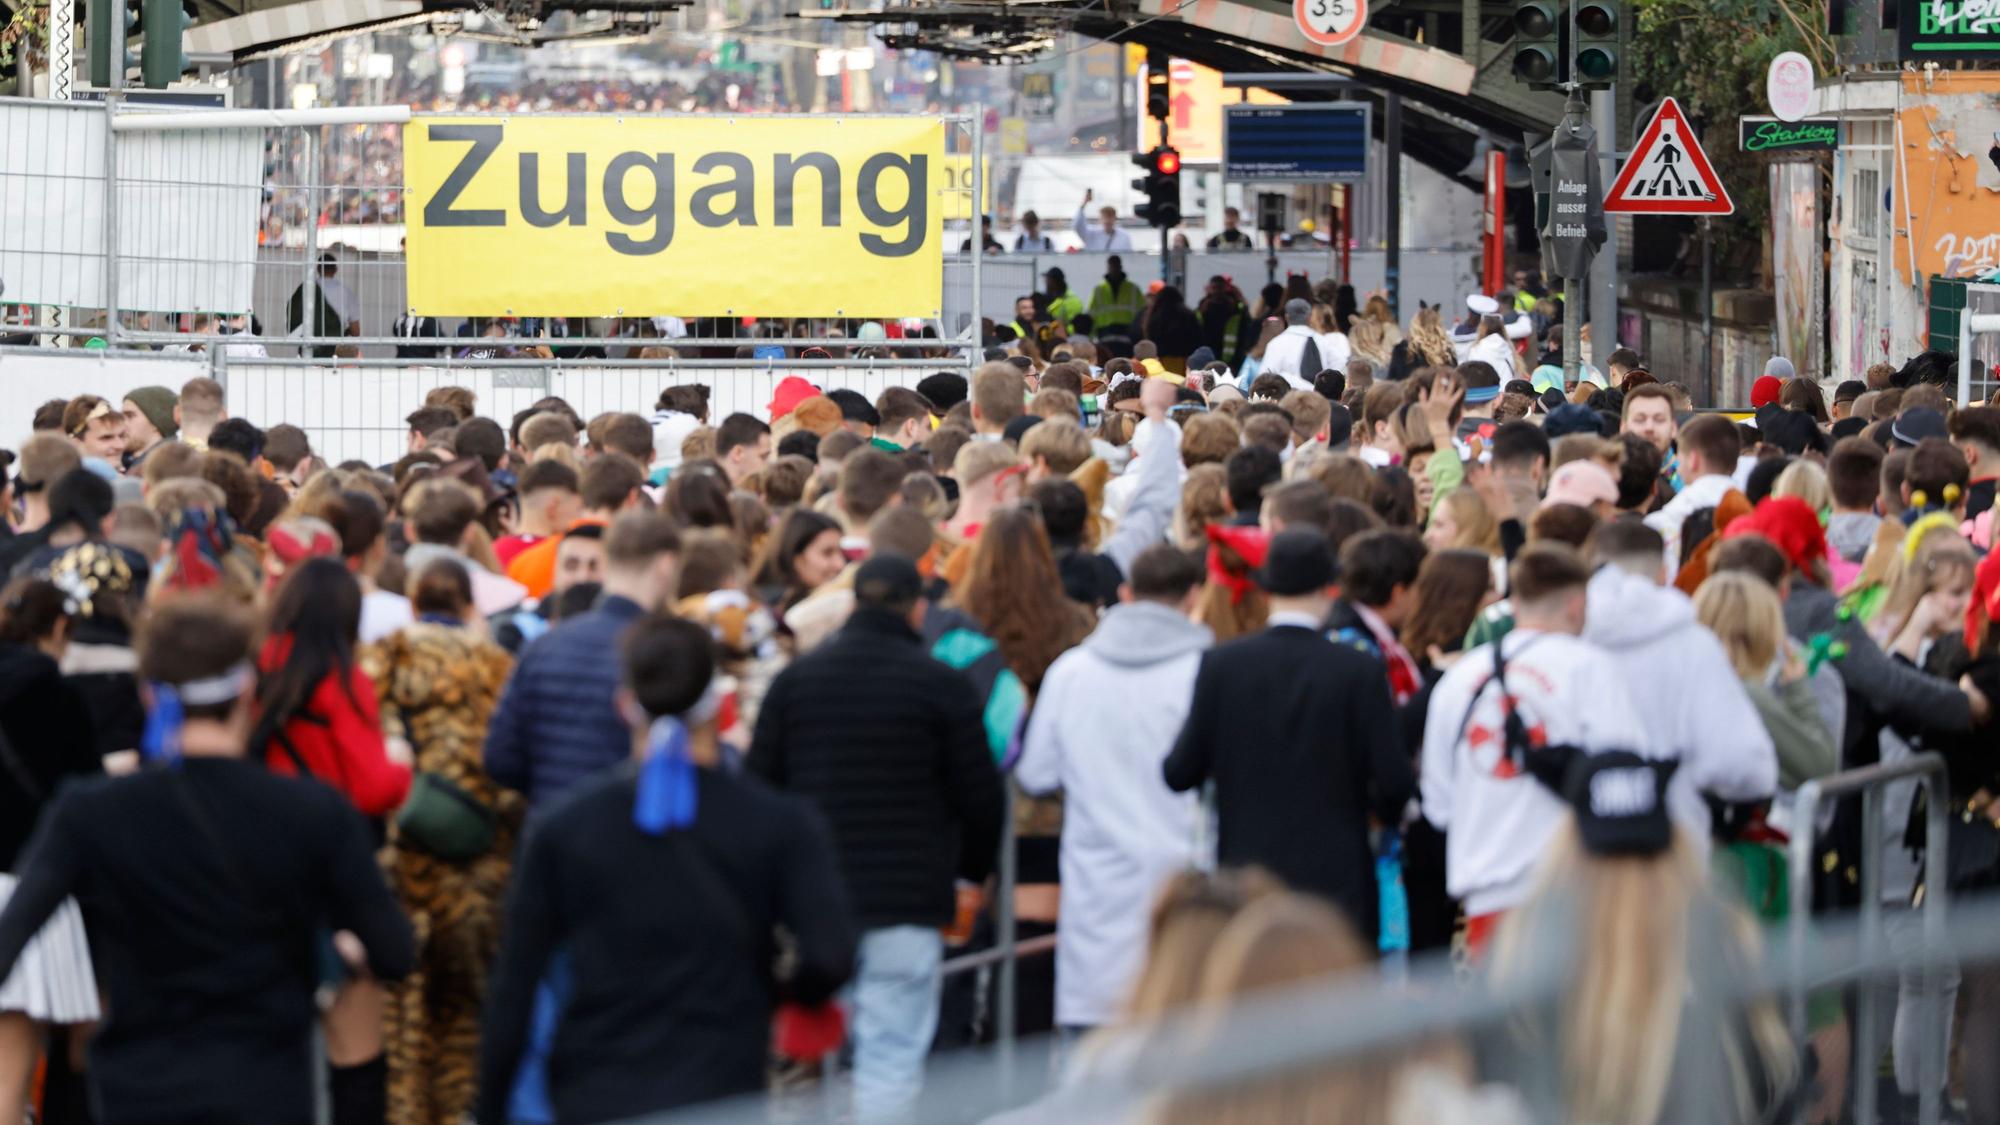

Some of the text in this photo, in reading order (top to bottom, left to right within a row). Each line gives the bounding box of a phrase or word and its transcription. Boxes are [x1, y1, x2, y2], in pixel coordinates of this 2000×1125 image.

[1746, 122, 1835, 151] Station
[424, 124, 928, 257] Zugang
[1557, 179, 1587, 196] Anlage
[1556, 203, 1587, 213] ausser
[1556, 223, 1587, 237] Betrieb
